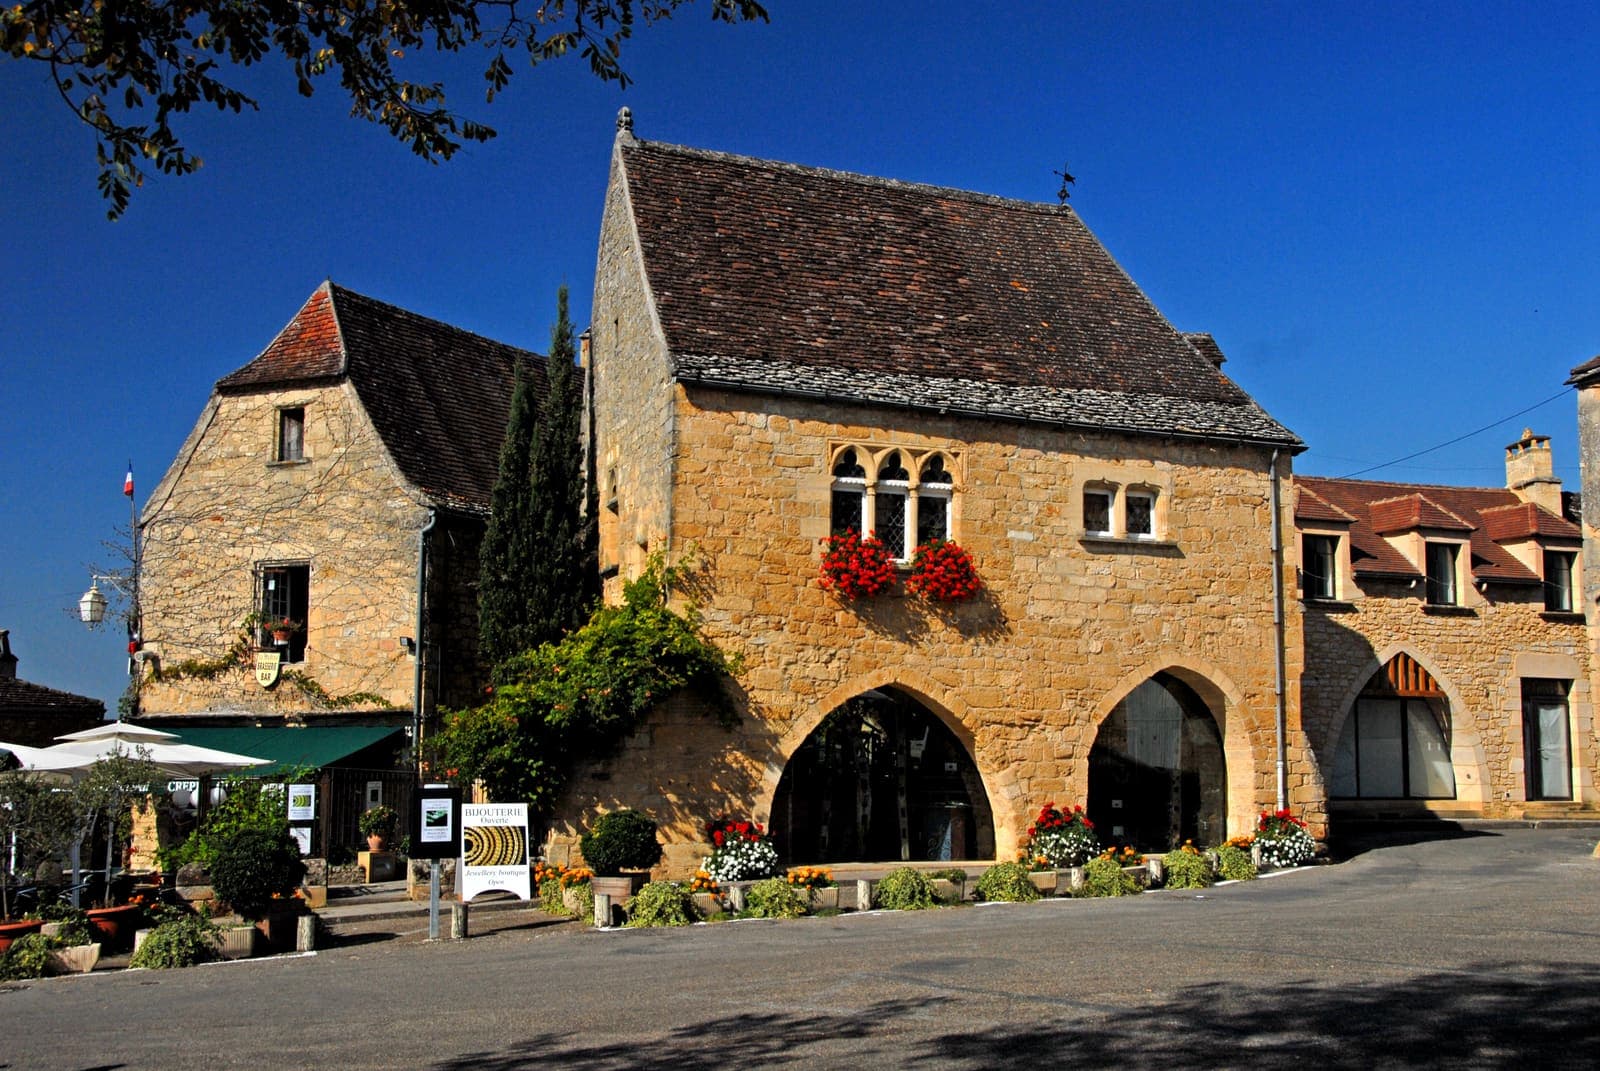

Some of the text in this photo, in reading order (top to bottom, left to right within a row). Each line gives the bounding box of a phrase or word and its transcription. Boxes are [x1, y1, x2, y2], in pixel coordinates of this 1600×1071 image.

[260, 672, 271, 680] BAR
[465, 808, 523, 817] BIJOUTERIE
[498, 869, 527, 877] boutique
